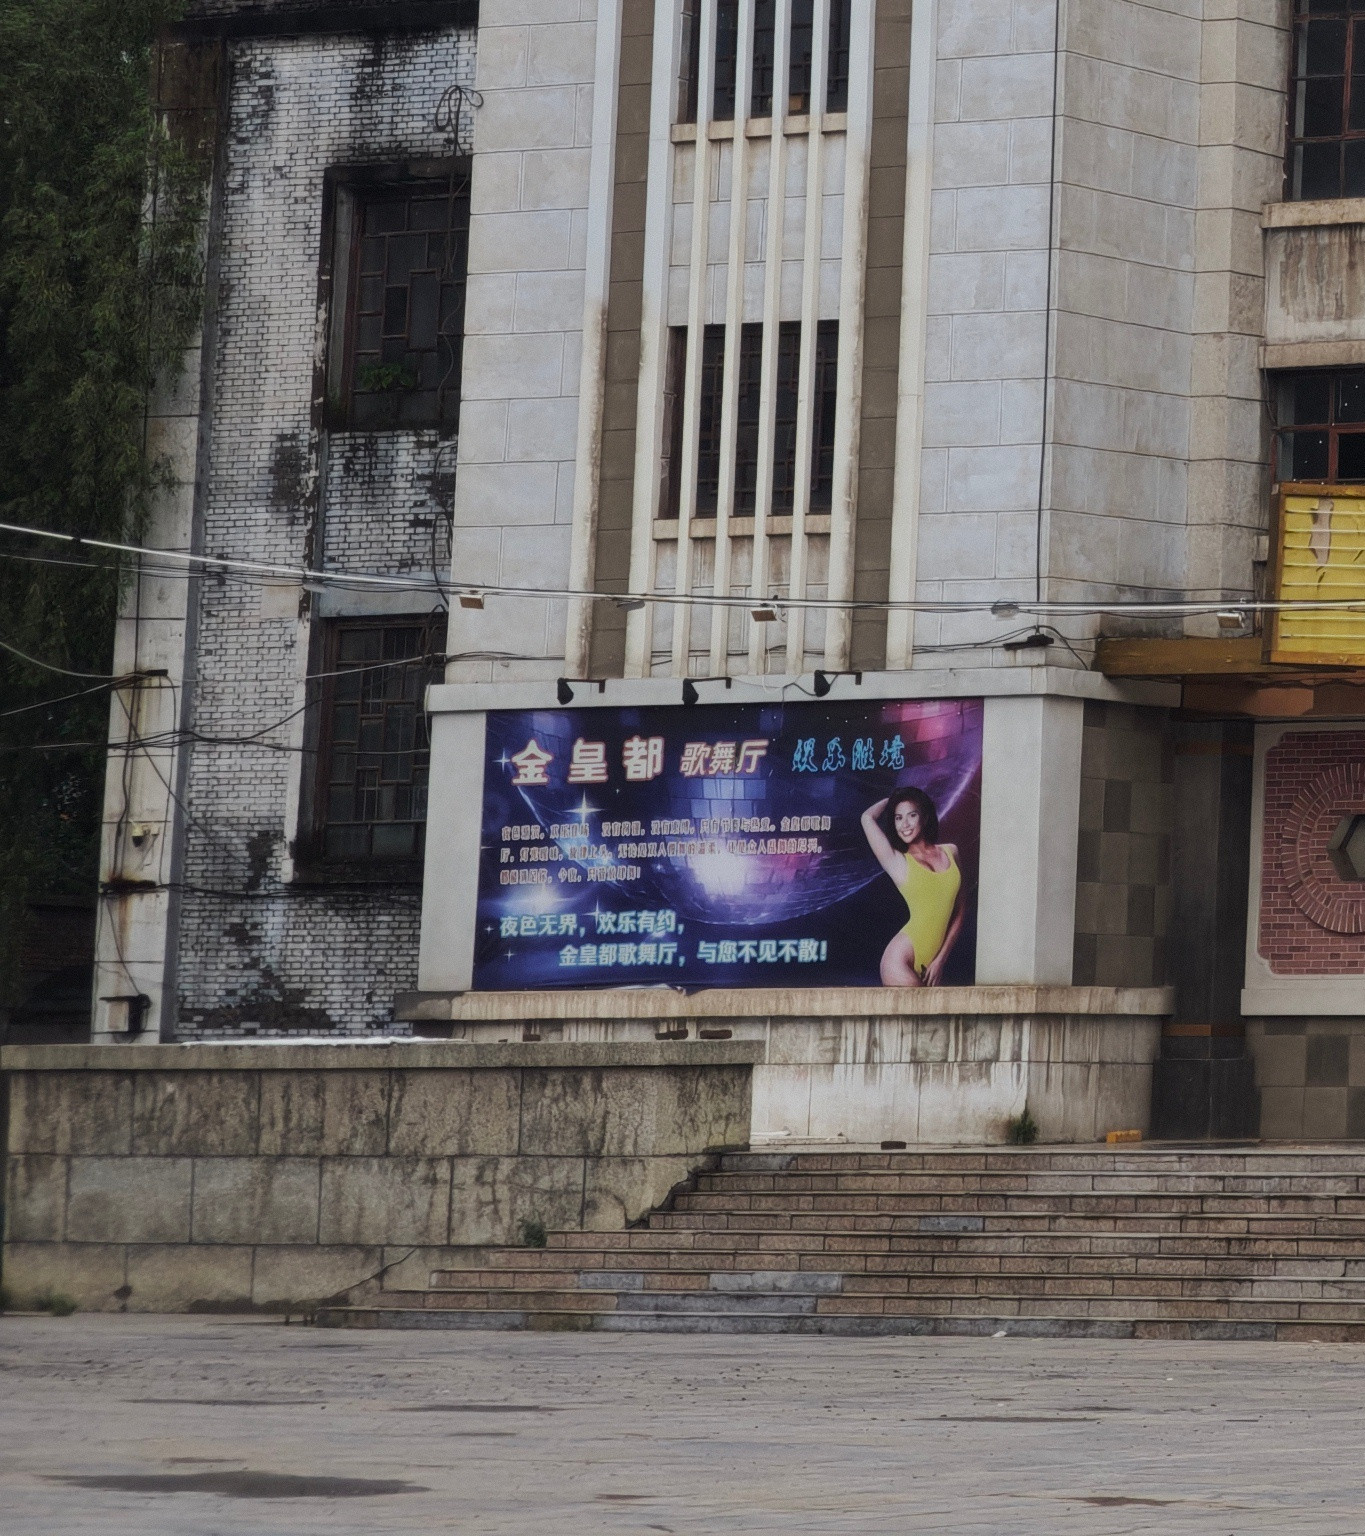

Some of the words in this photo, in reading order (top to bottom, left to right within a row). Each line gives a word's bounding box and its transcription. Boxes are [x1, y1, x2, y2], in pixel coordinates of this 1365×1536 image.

[511, 735, 664, 786] 金皇都
[680, 739, 769, 777] 歌舞厅
